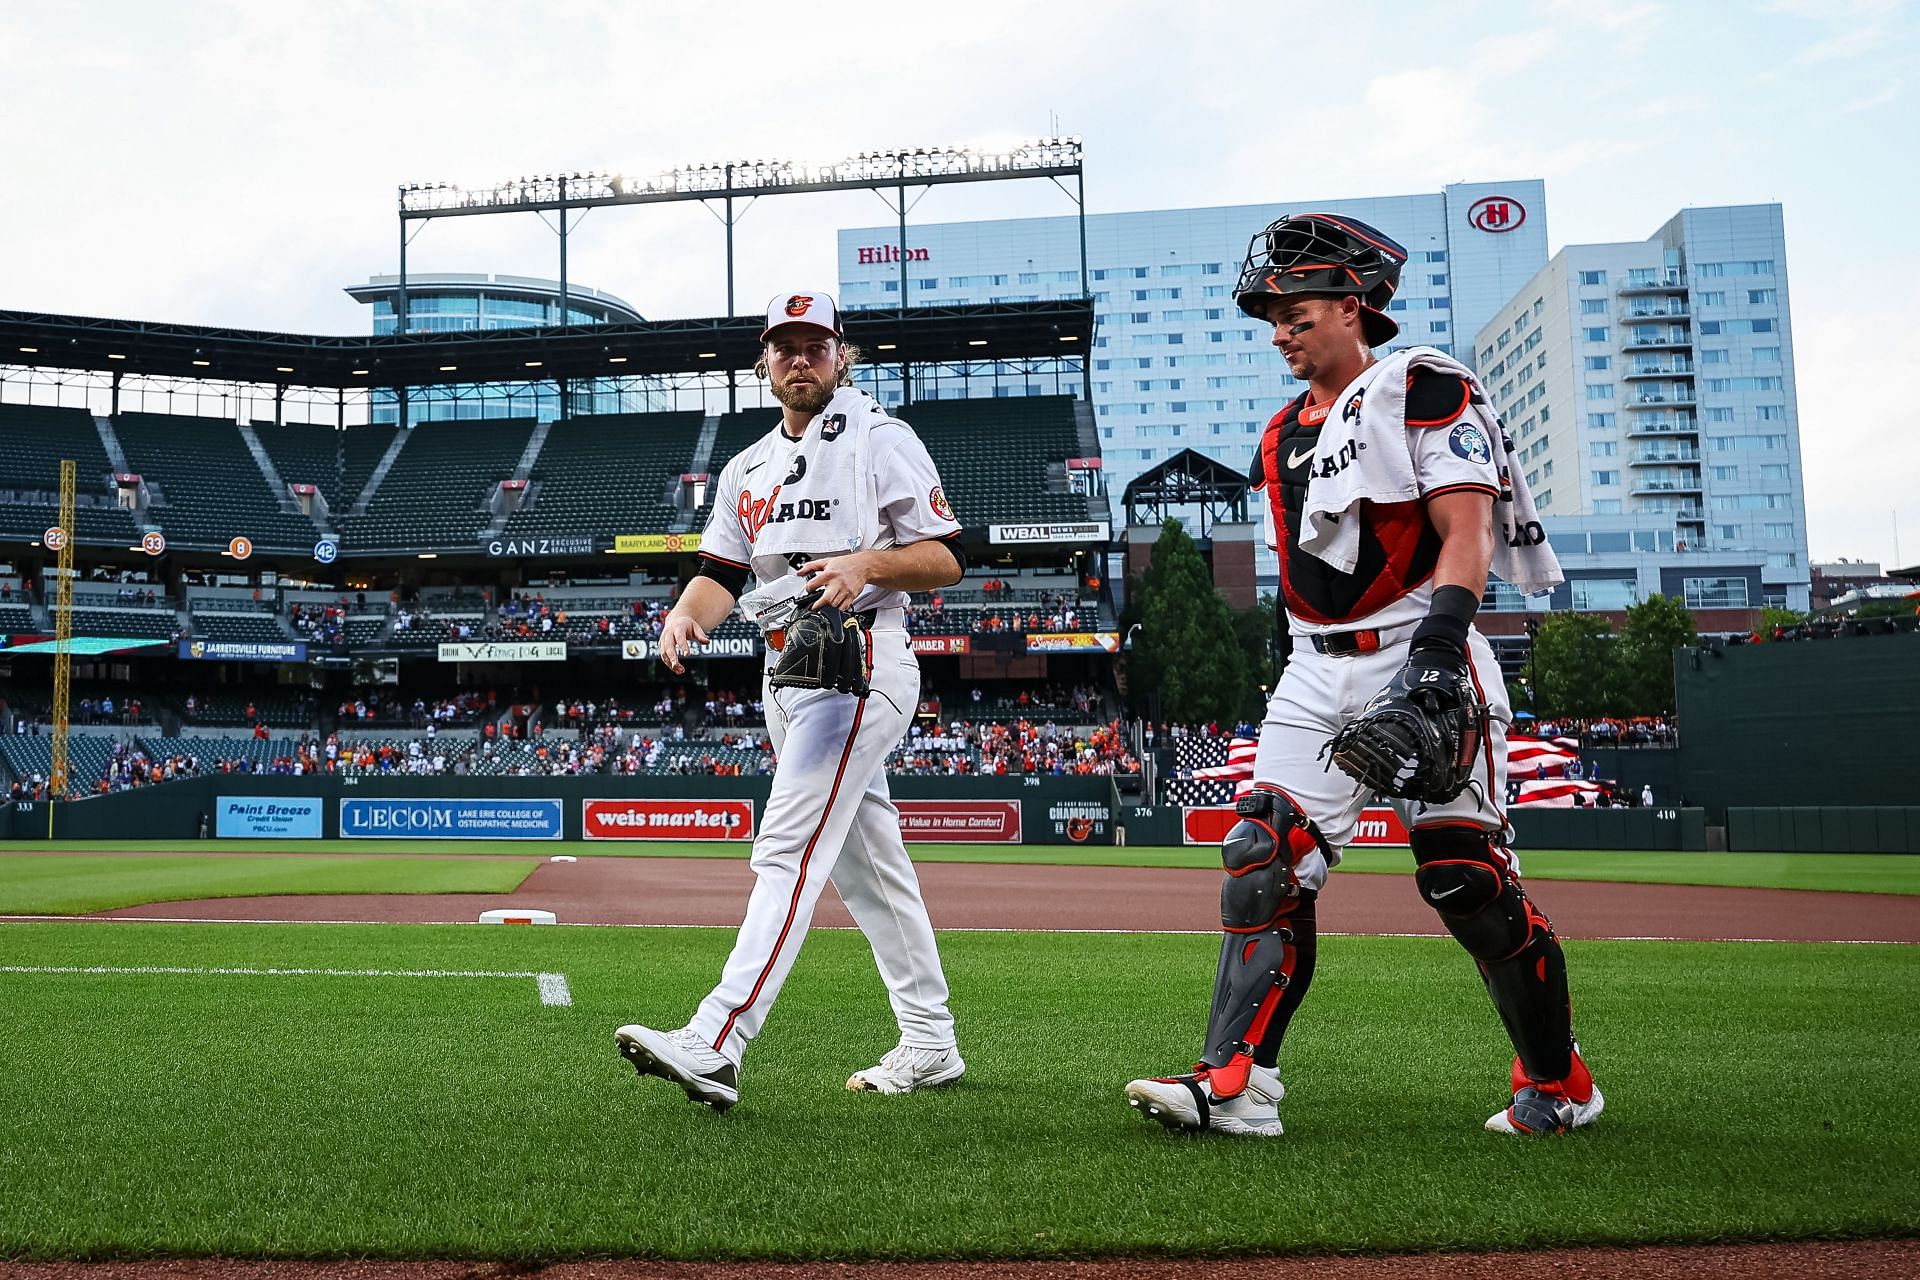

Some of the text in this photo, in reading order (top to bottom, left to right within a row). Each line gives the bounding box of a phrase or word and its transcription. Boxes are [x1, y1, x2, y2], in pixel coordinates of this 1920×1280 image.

[858, 244, 929, 264] Hilton
[47, 532, 65, 545] 22
[1002, 527, 1049, 539] WBAL
[146, 537, 162, 550] 33
[489, 540, 549, 555] GANZ
[551, 538, 592, 546] EXCLUSIVE
[621, 537, 701, 549] MARYLAND LOT
[237, 542, 245, 555] 8
[317, 545, 332, 558] 42
[1357, 630, 1373, 645] 27
[258, 644, 296, 656] FURNITURE
[701, 639, 753, 654] UNION
[912, 640, 945, 651] UMBER
[1023, 777, 1040, 786] 398
[266, 805, 311, 816] Breeze
[457, 810, 544, 818] LAKE ERIE COLLEGE OF
[1049, 808, 1109, 819] CHAMPIONS
[1134, 807, 1153, 817] 376
[1656, 809, 1676, 820] 410
[457, 819, 549, 828] OSTEOPATHIC MEDICINE
[595, 809, 741, 827] weis markets
[908, 817, 931, 827] Value
[942, 817, 966, 827] Home
[968, 817, 1001, 827] Comfort
